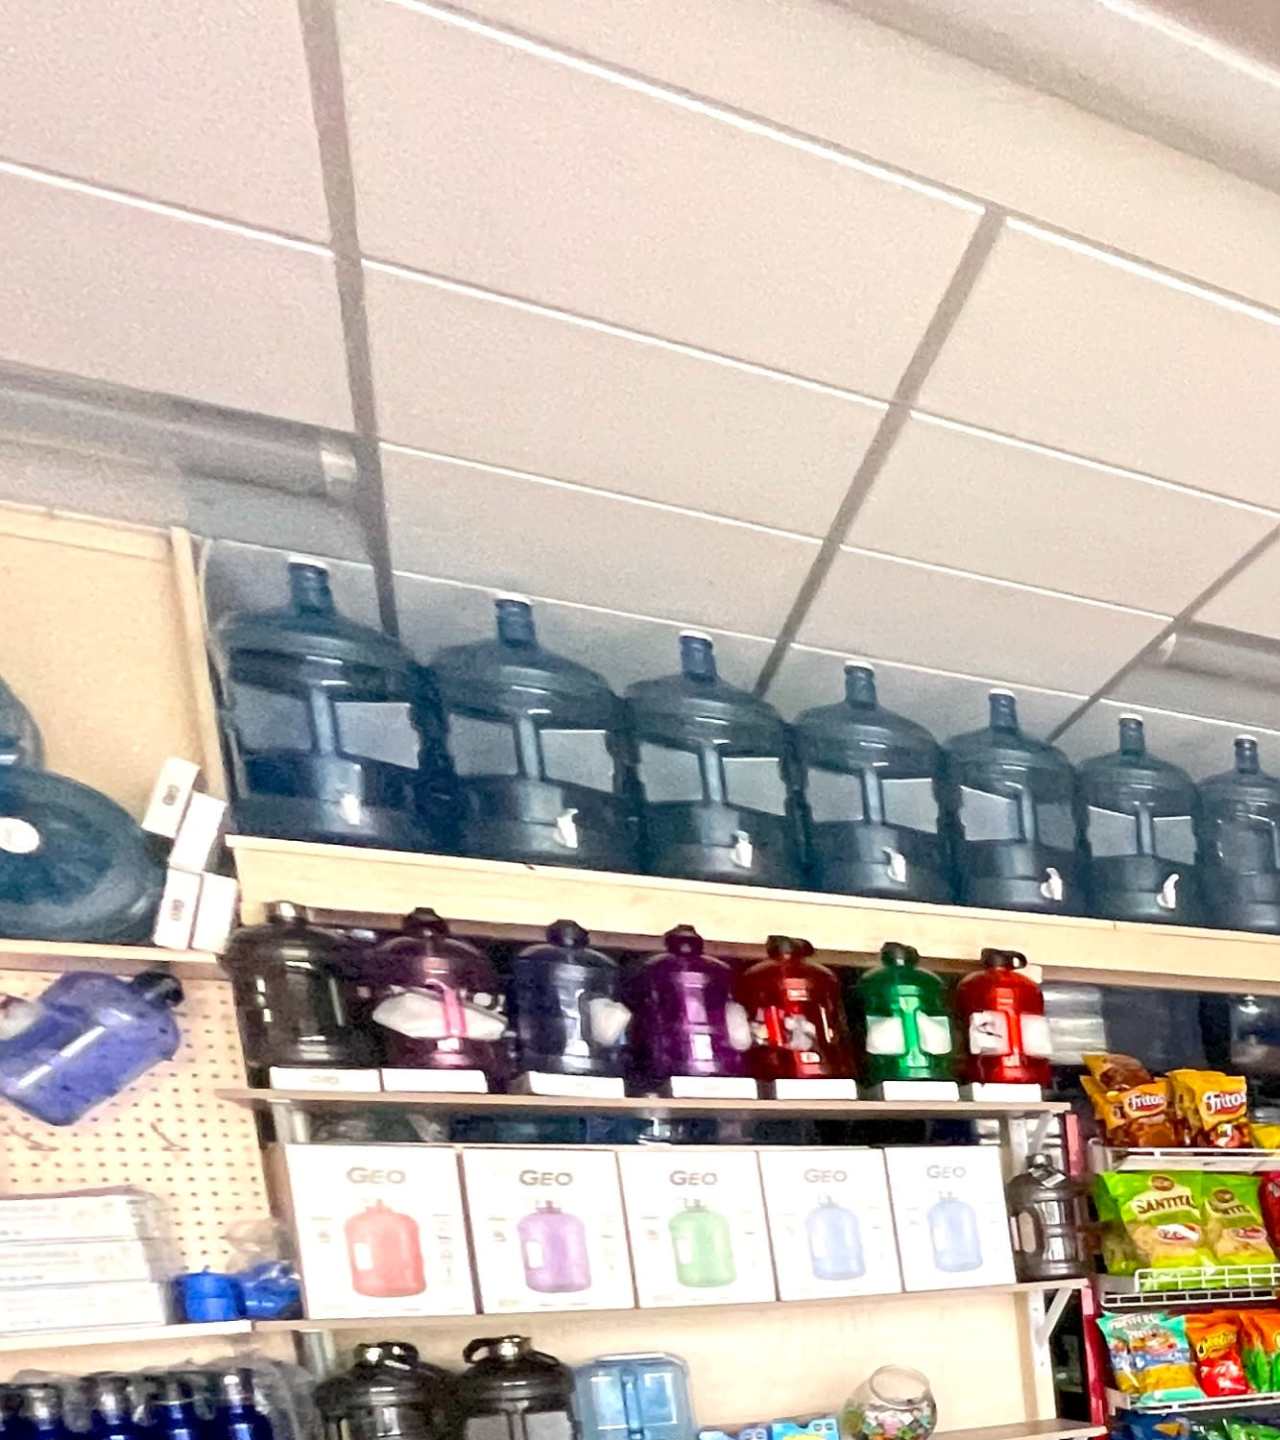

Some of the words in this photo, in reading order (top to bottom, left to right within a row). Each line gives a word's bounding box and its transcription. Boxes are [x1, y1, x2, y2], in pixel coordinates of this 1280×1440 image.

[346, 1165, 406, 1185] GEO
[518, 1169, 573, 1187] GEO
[669, 1169, 718, 1187] GEO
[804, 1167, 848, 1184] GEO
[925, 1164, 967, 1180] GEO
